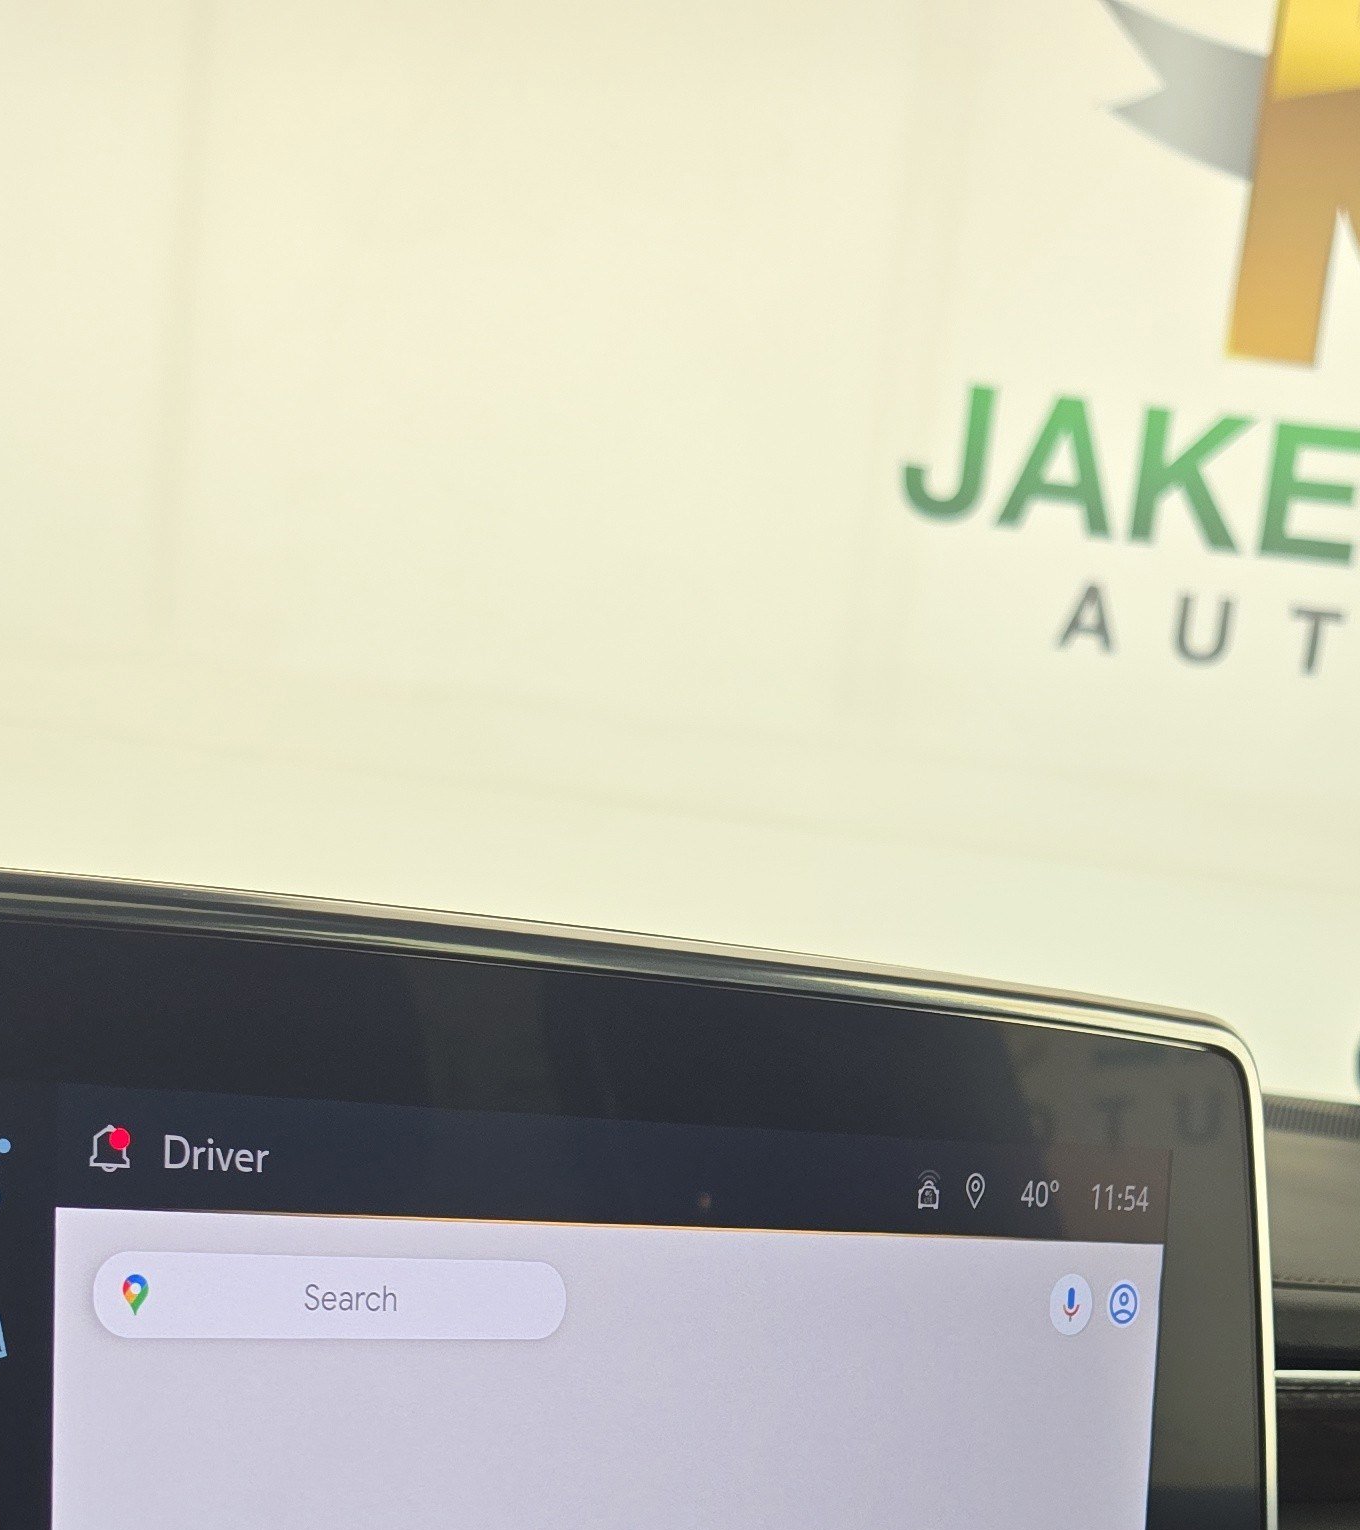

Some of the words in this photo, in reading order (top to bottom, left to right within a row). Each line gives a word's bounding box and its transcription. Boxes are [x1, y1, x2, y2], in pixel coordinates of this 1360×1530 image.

[162, 1133, 270, 1174] Driver
[1091, 1183, 1149, 1213] 11:54
[304, 1284, 397, 1313] Search
